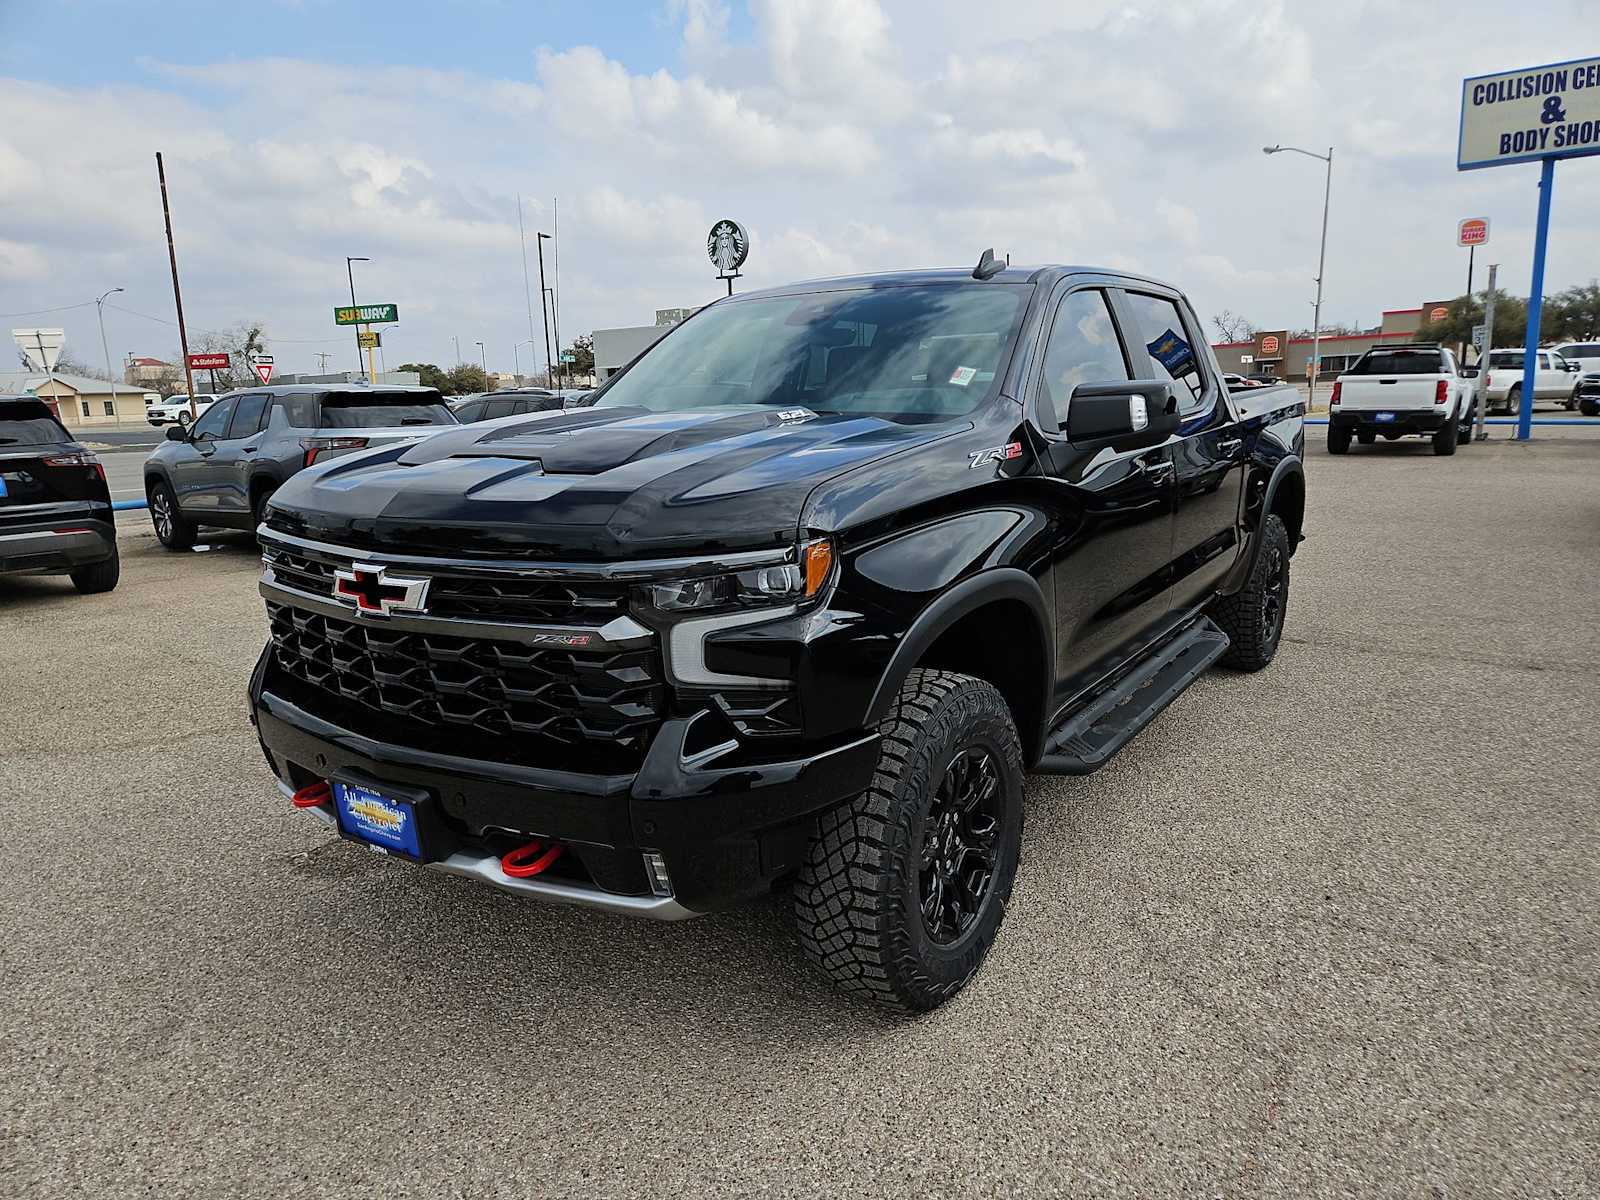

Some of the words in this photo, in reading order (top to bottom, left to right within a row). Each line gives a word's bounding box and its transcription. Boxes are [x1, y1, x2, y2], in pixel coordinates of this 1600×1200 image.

[1473, 70, 1567, 105] COLLISION
[1541, 96, 1566, 124] &
[1499, 127, 1549, 154] BODY
[1462, 231, 1485, 240] KING
[338, 307, 388, 321] SUBWAY
[968, 442, 1022, 469] ZR2
[533, 634, 590, 645] ZR2
[343, 791, 357, 804] All
[360, 796, 407, 821] American
[352, 808, 403, 833] Chevrolet
